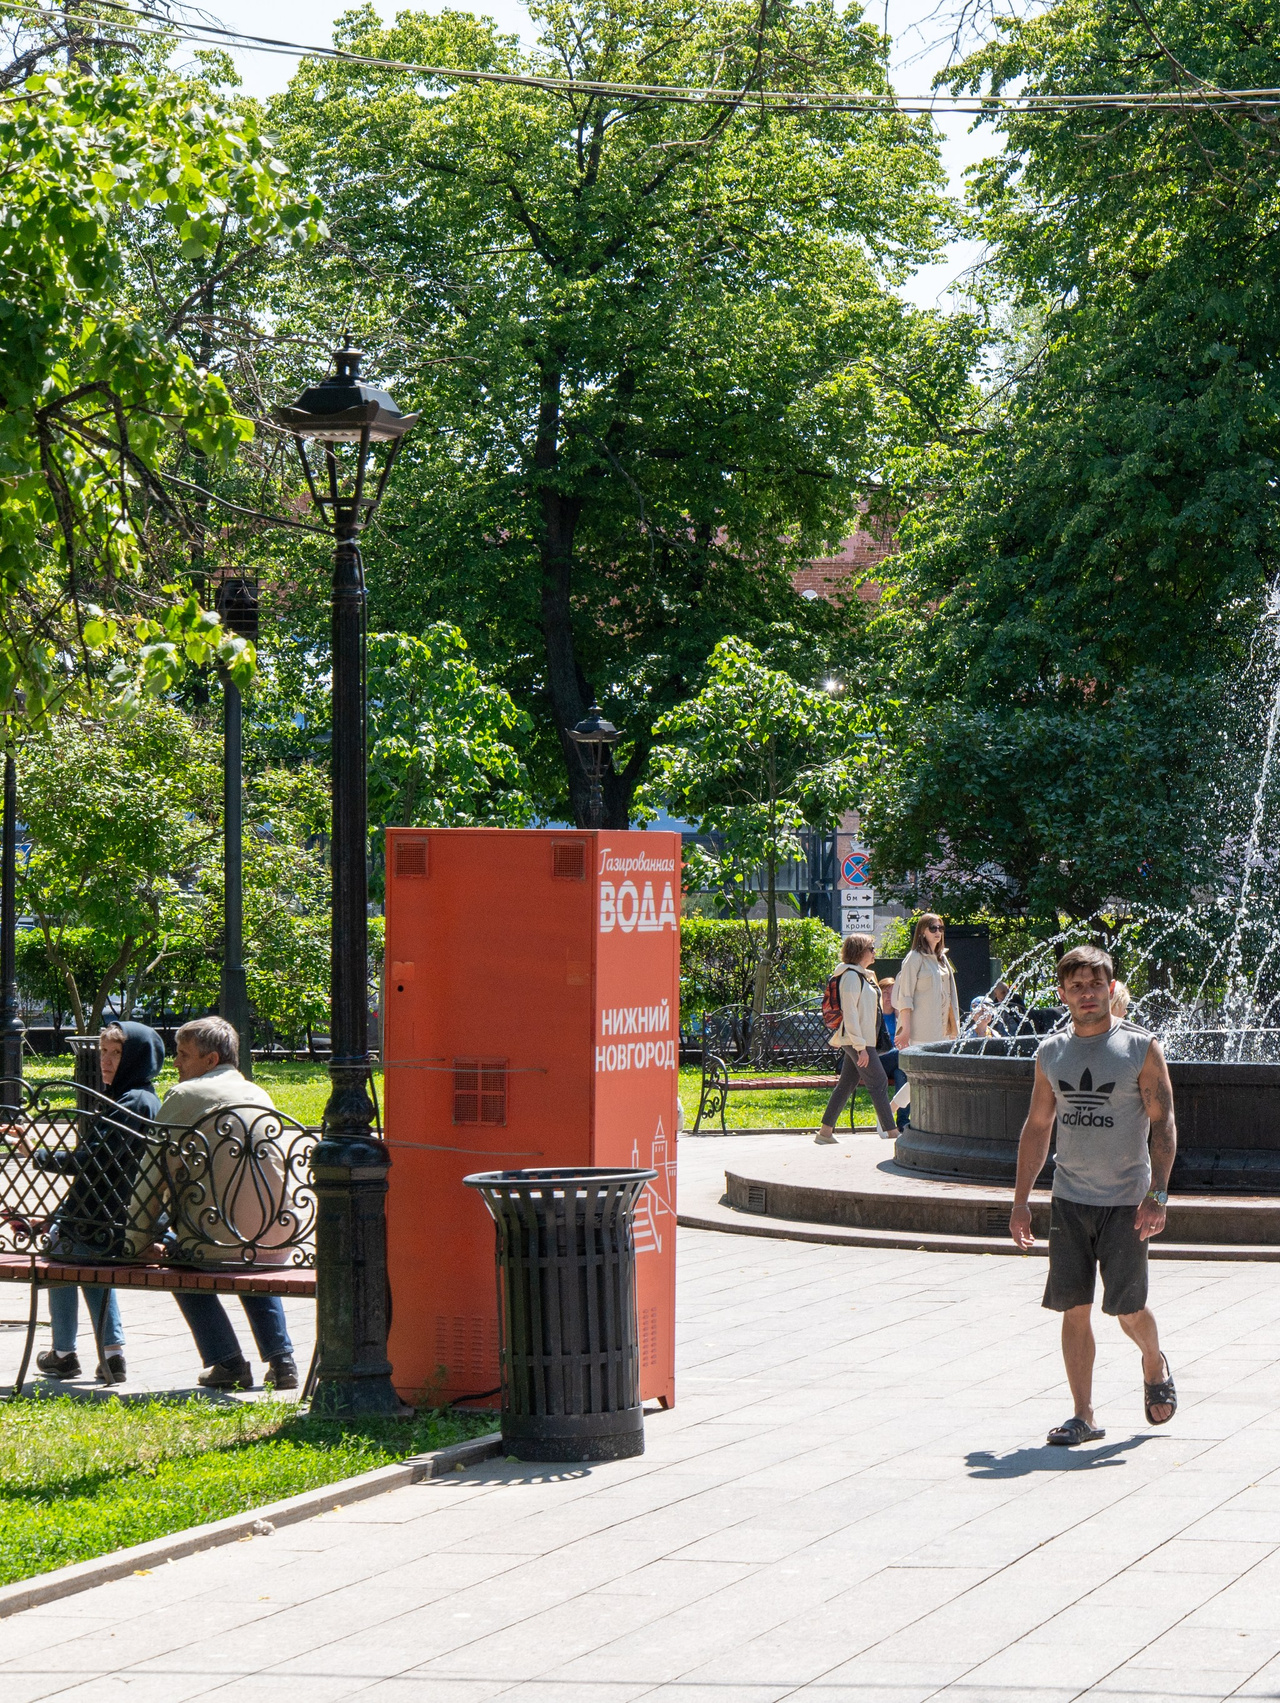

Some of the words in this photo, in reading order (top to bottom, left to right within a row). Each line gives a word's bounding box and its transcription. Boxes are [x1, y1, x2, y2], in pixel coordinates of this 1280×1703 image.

[599, 848, 675, 877] Газированная
[600, 880, 678, 933] ВОДА
[601, 998, 669, 1036] НИЖНИЙ
[595, 1040, 675, 1072] НОВГОРОД
[1062, 1111, 1114, 1128] adidas
